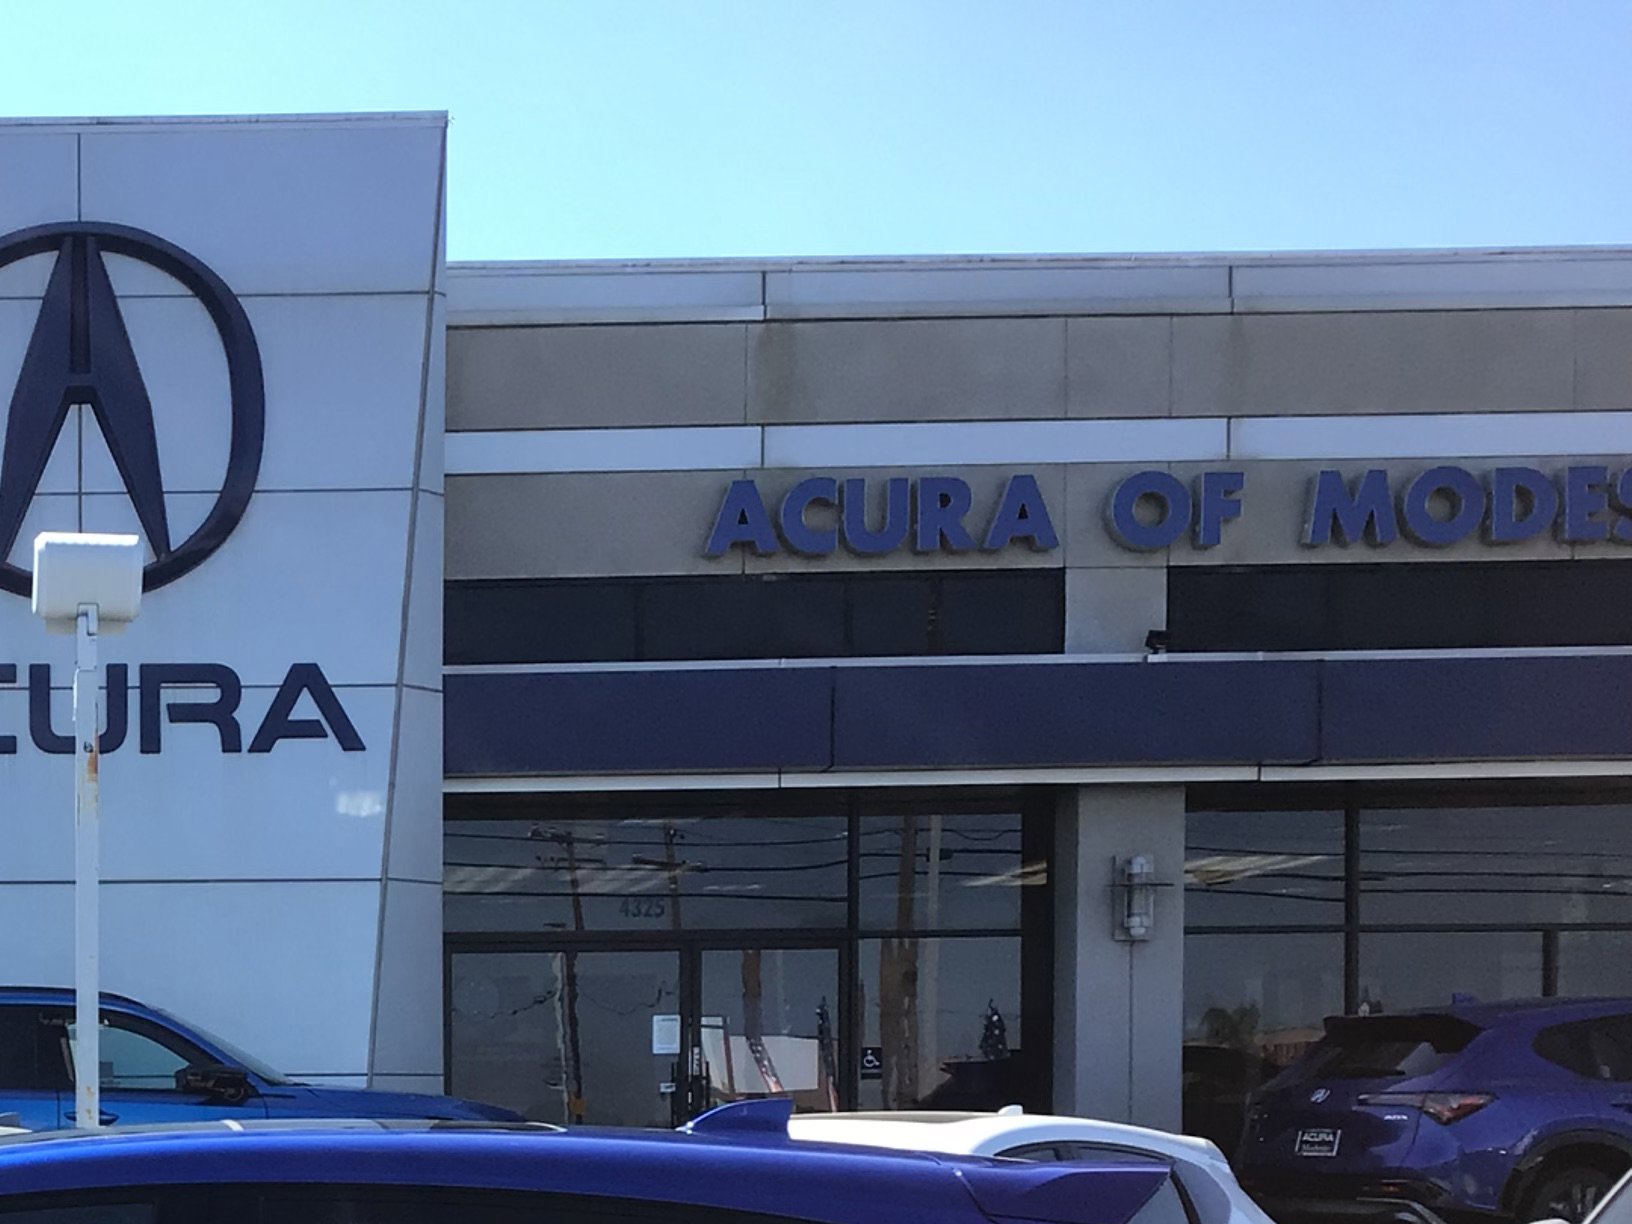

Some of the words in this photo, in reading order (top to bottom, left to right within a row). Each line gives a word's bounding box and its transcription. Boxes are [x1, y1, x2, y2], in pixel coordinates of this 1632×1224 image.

[704, 474, 1060, 555] ACURA
[1109, 470, 1245, 551] OF
[619, 896, 665, 918] 4325
